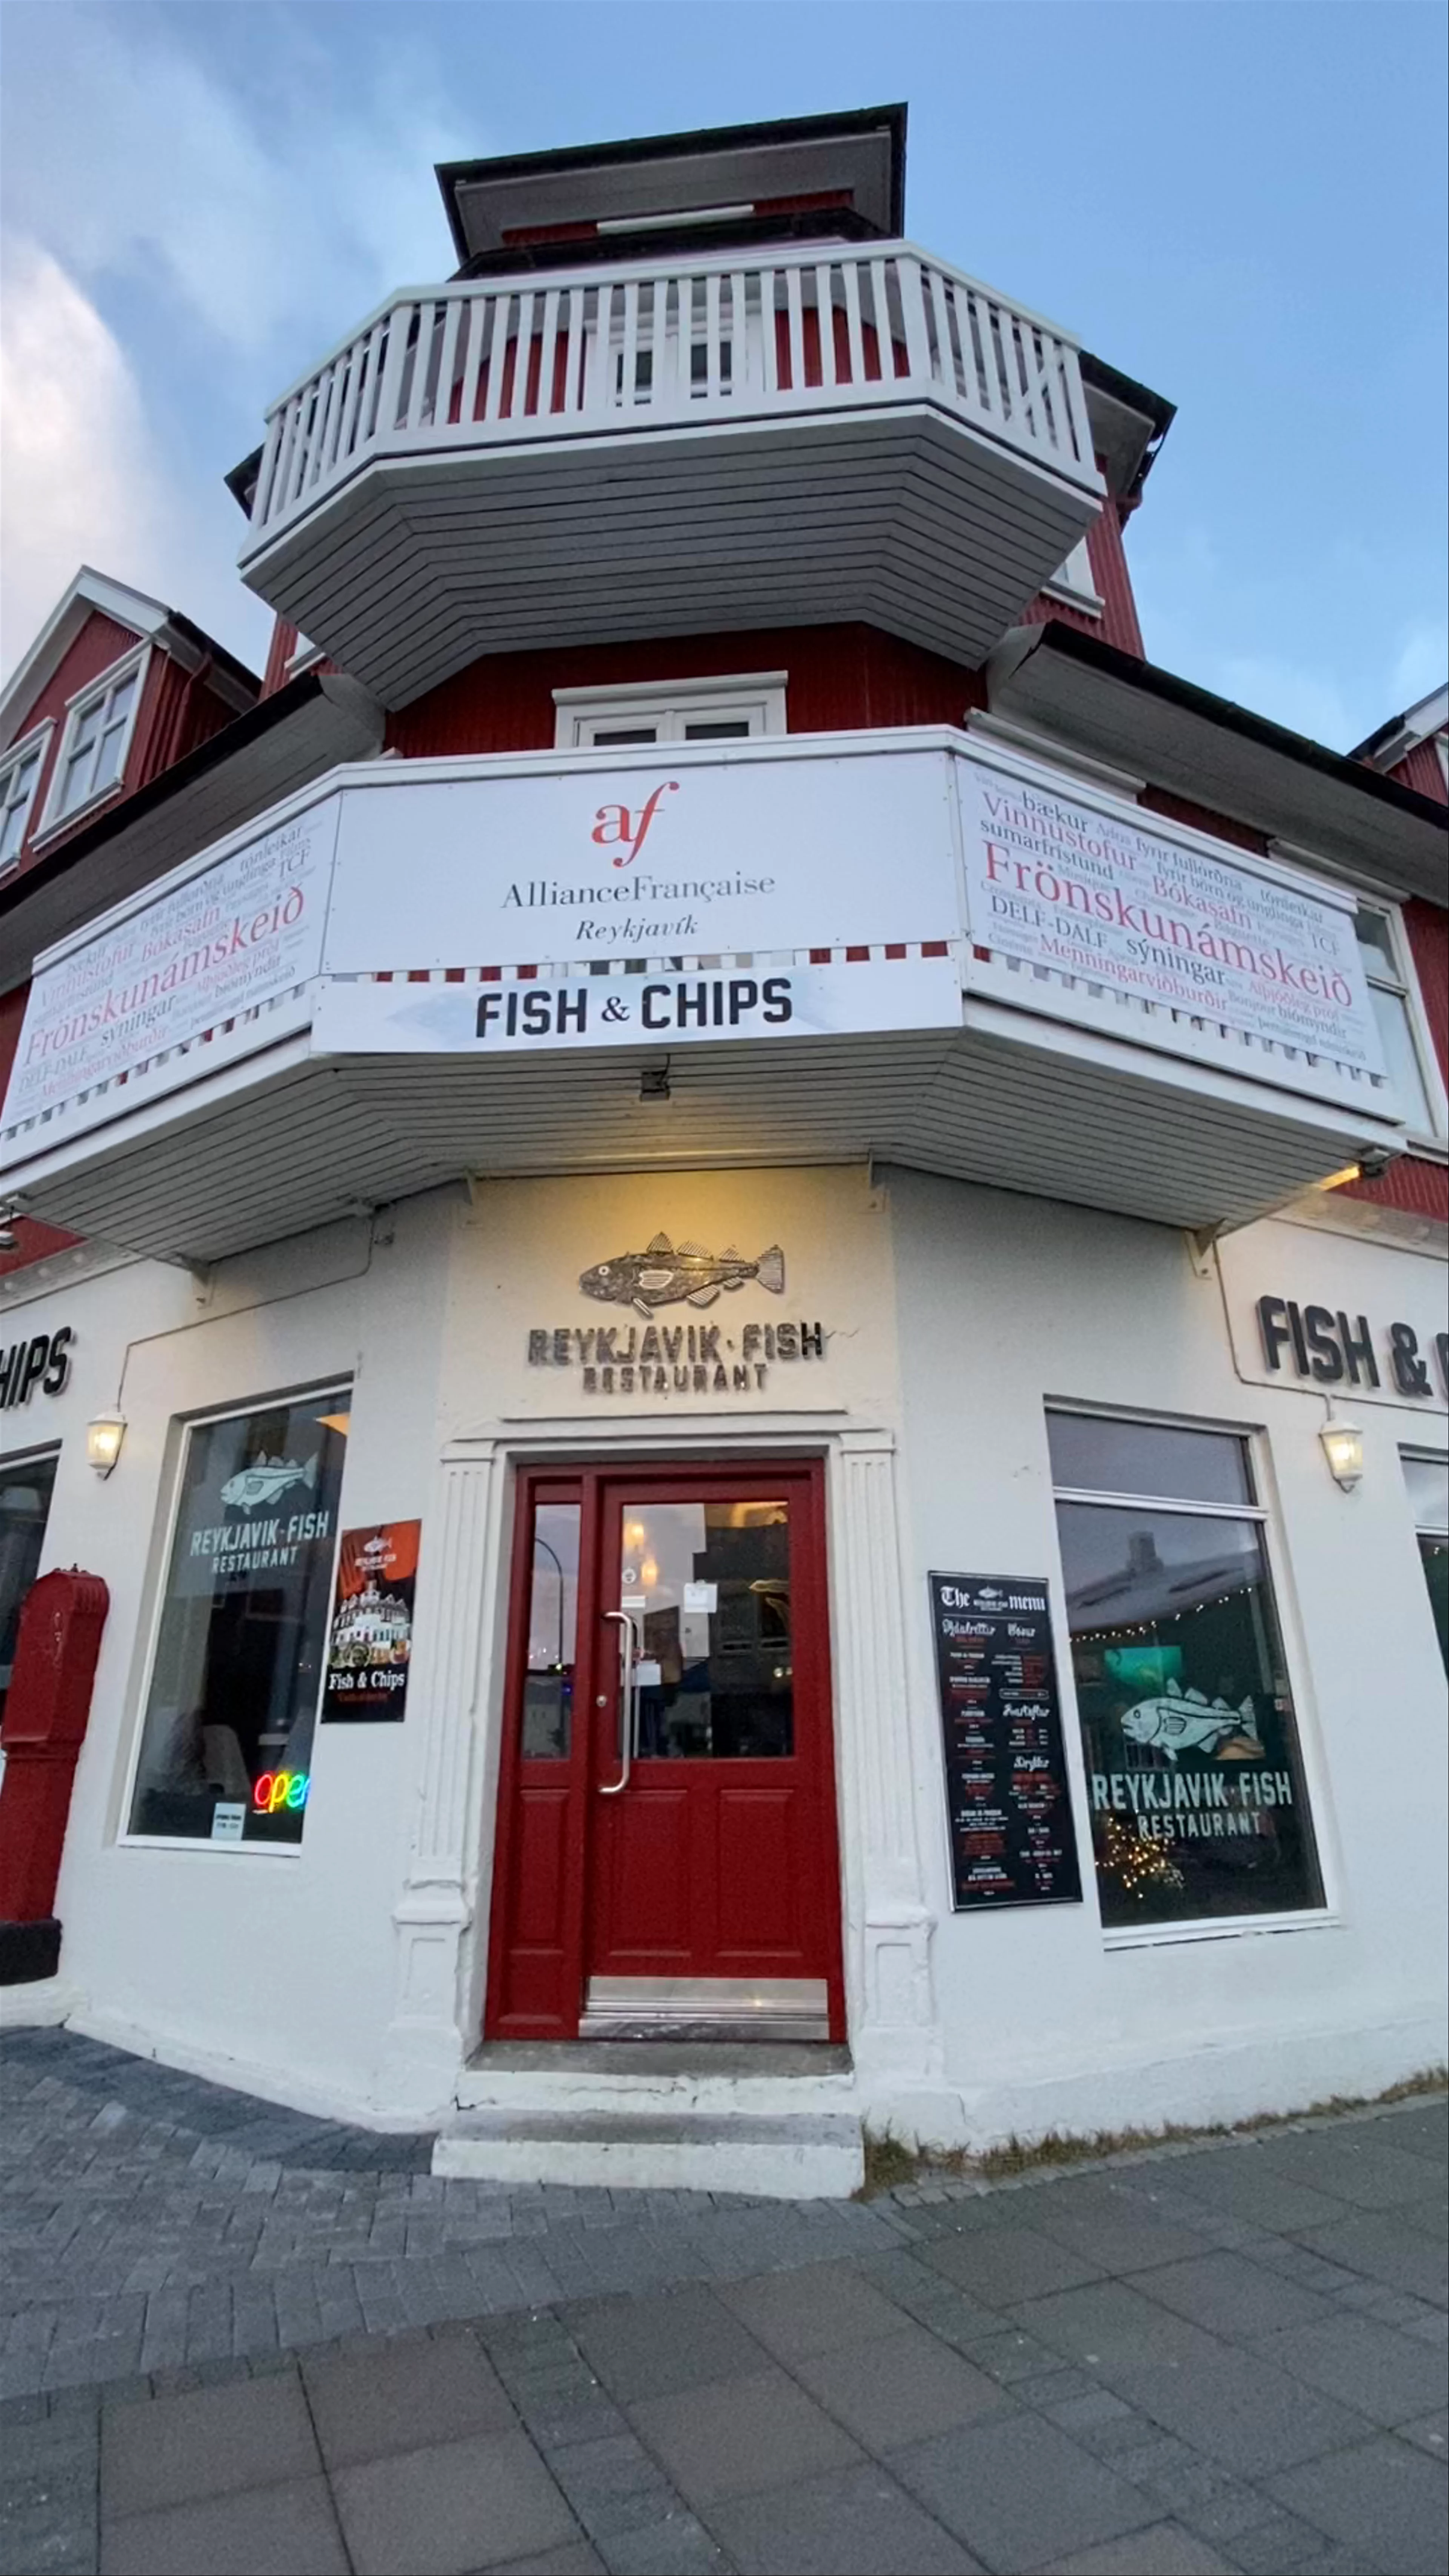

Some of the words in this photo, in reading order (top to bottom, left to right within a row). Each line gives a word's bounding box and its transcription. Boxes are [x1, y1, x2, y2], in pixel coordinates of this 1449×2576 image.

[591, 781, 680, 867] af
[983, 792, 1135, 869] Vinnustofur
[1023, 791, 1087, 832] bækur
[985, 841, 1351, 1005] Frönskunámskeið
[992, 895, 1105, 947] DELF-DALF
[1153, 875, 1251, 929] Bókasafn
[25, 884, 303, 1064] Frönskunámskeið
[1041, 934, 1226, 1009] Menningarviðburðir
[1127, 939, 1224, 984] sýningar
[101, 995, 176, 1047] sýningar
[476, 989, 588, 1038] FISH
[601, 997, 630, 1022] &
[641, 978, 792, 1028] CHIPS
[529, 1324, 721, 1363] REYKJAVIK
[743, 1321, 823, 1359] FISH
[1256, 1295, 1380, 1387] FISH
[1389, 1322, 1433, 1397] &
[582, 1363, 768, 1394] RESTAURANT
[191, 1518, 280, 1556] REYKJAVIK
[287, 1511, 329, 1542] FISH
[212, 1546, 298, 1574] RESTAURANT
[940, 1586, 970, 1608] The
[1009, 1596, 1046, 1611] menu
[328, 1673, 354, 1690] Fish
[357, 1672, 367, 1688] &
[371, 1670, 405, 1690] Chips
[1092, 1773, 1228, 1810] REYKJAVIK
[1239, 1772, 1292, 1805] FISH
[1137, 1812, 1262, 1841] RESTAURANT
